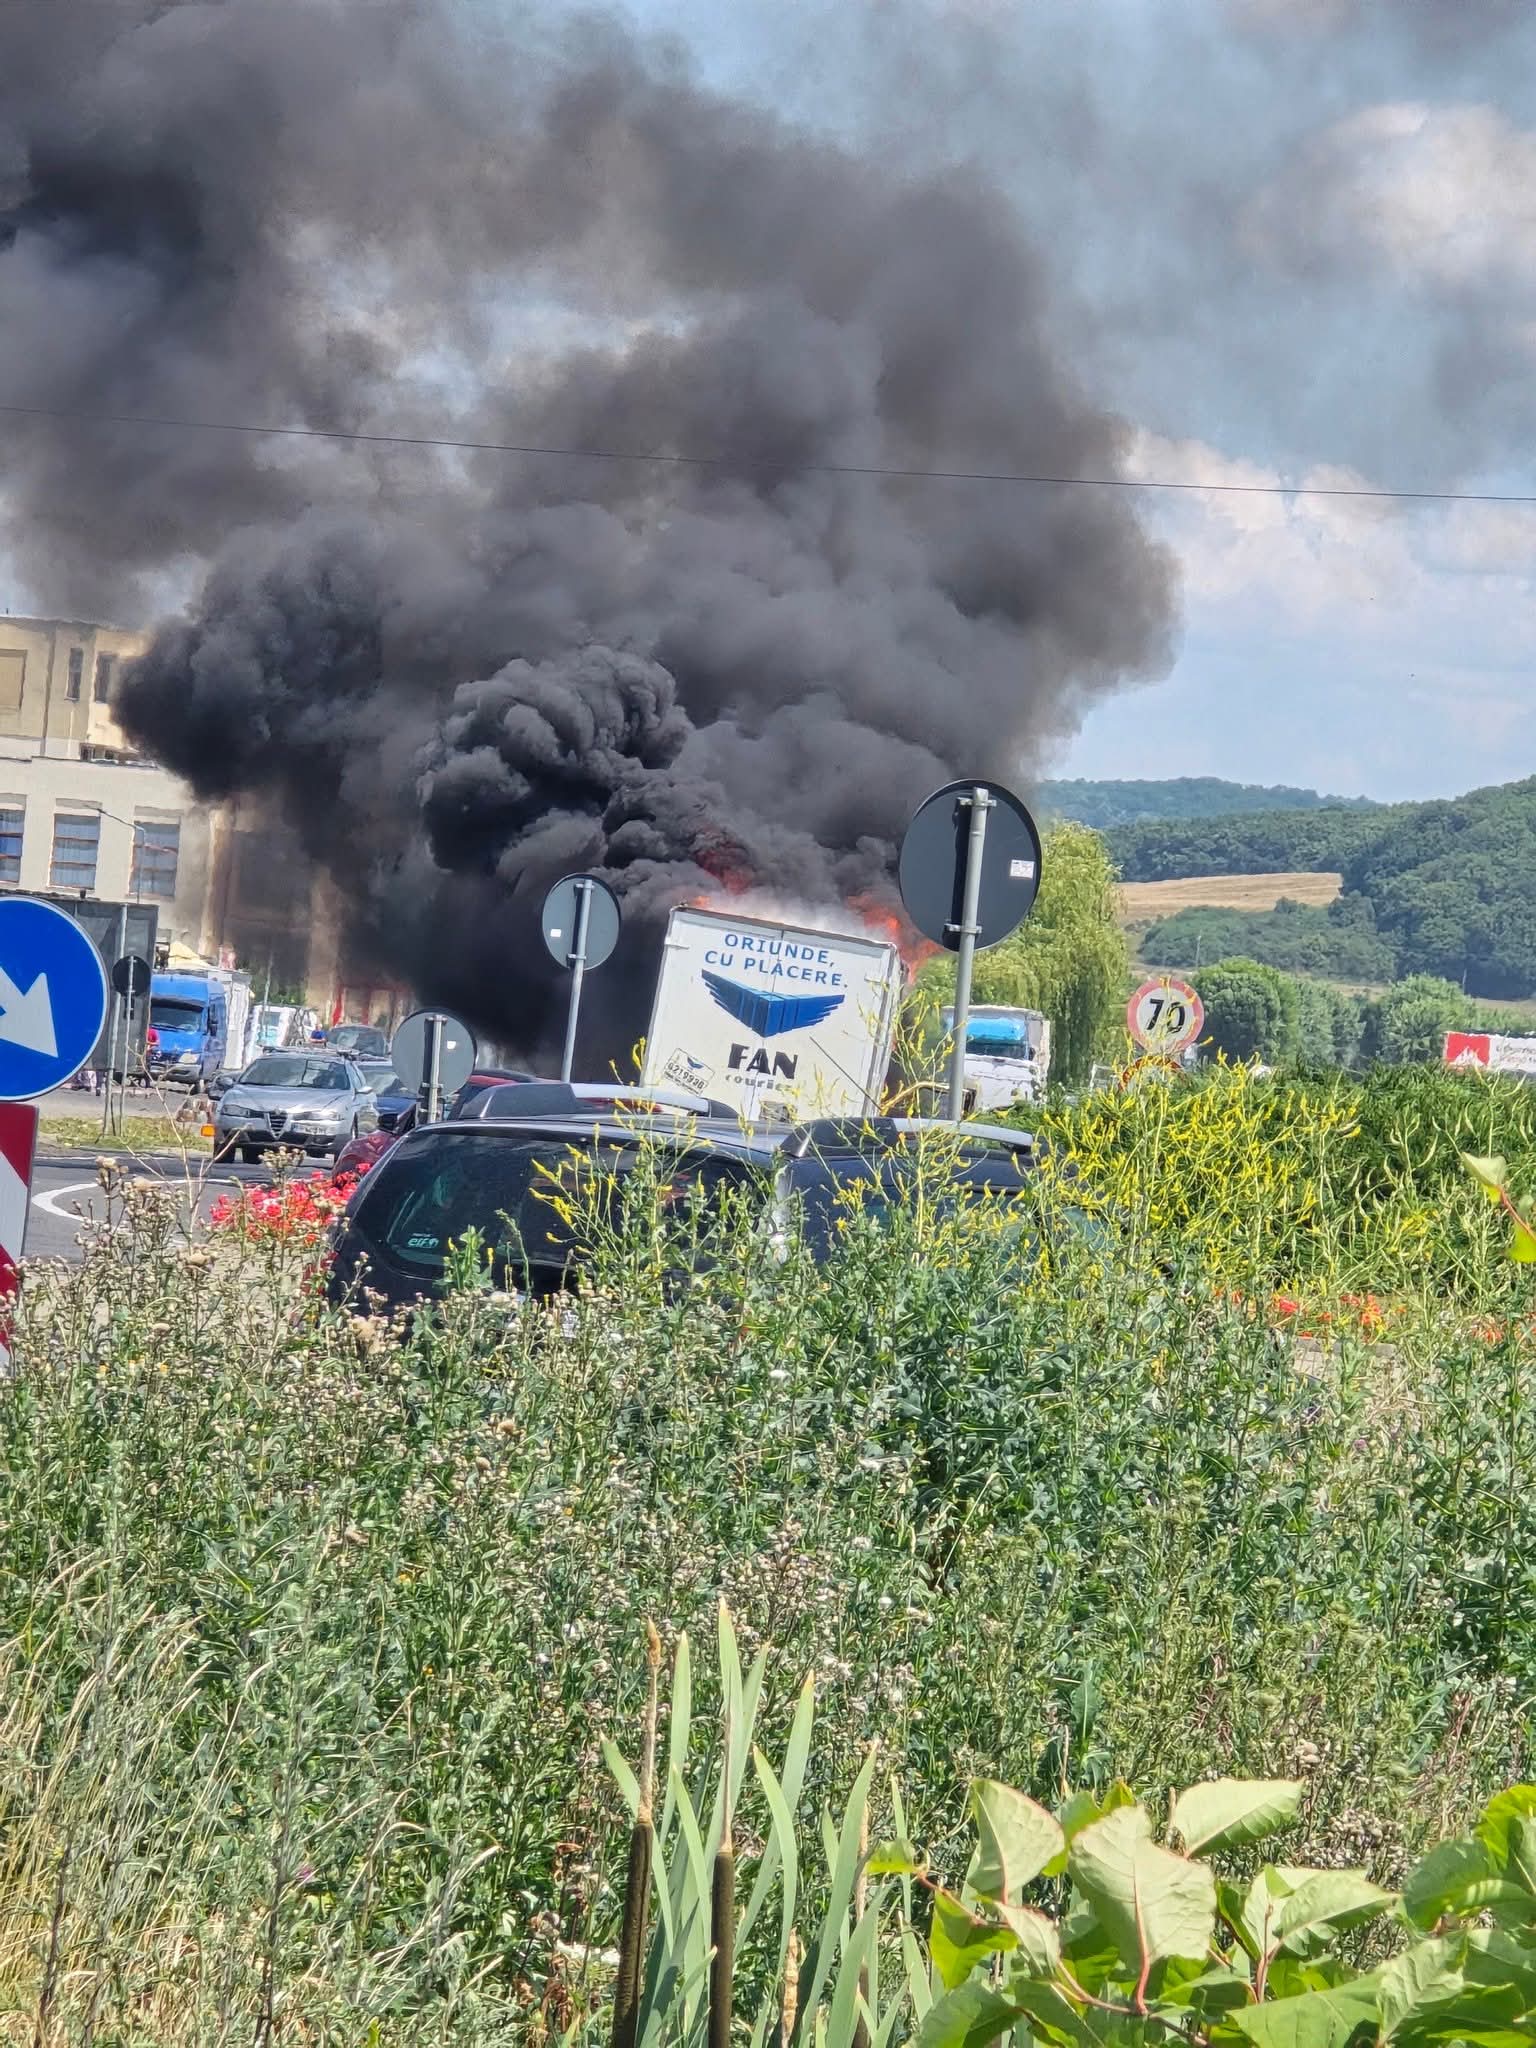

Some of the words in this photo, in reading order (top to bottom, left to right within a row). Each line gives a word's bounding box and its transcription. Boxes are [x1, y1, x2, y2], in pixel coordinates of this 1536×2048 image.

[704, 950, 734, 967] CU
[724, 934, 835, 967] ORIUNDE,
[1146, 998, 1186, 1034] 70
[727, 1043, 799, 1080] FAN
